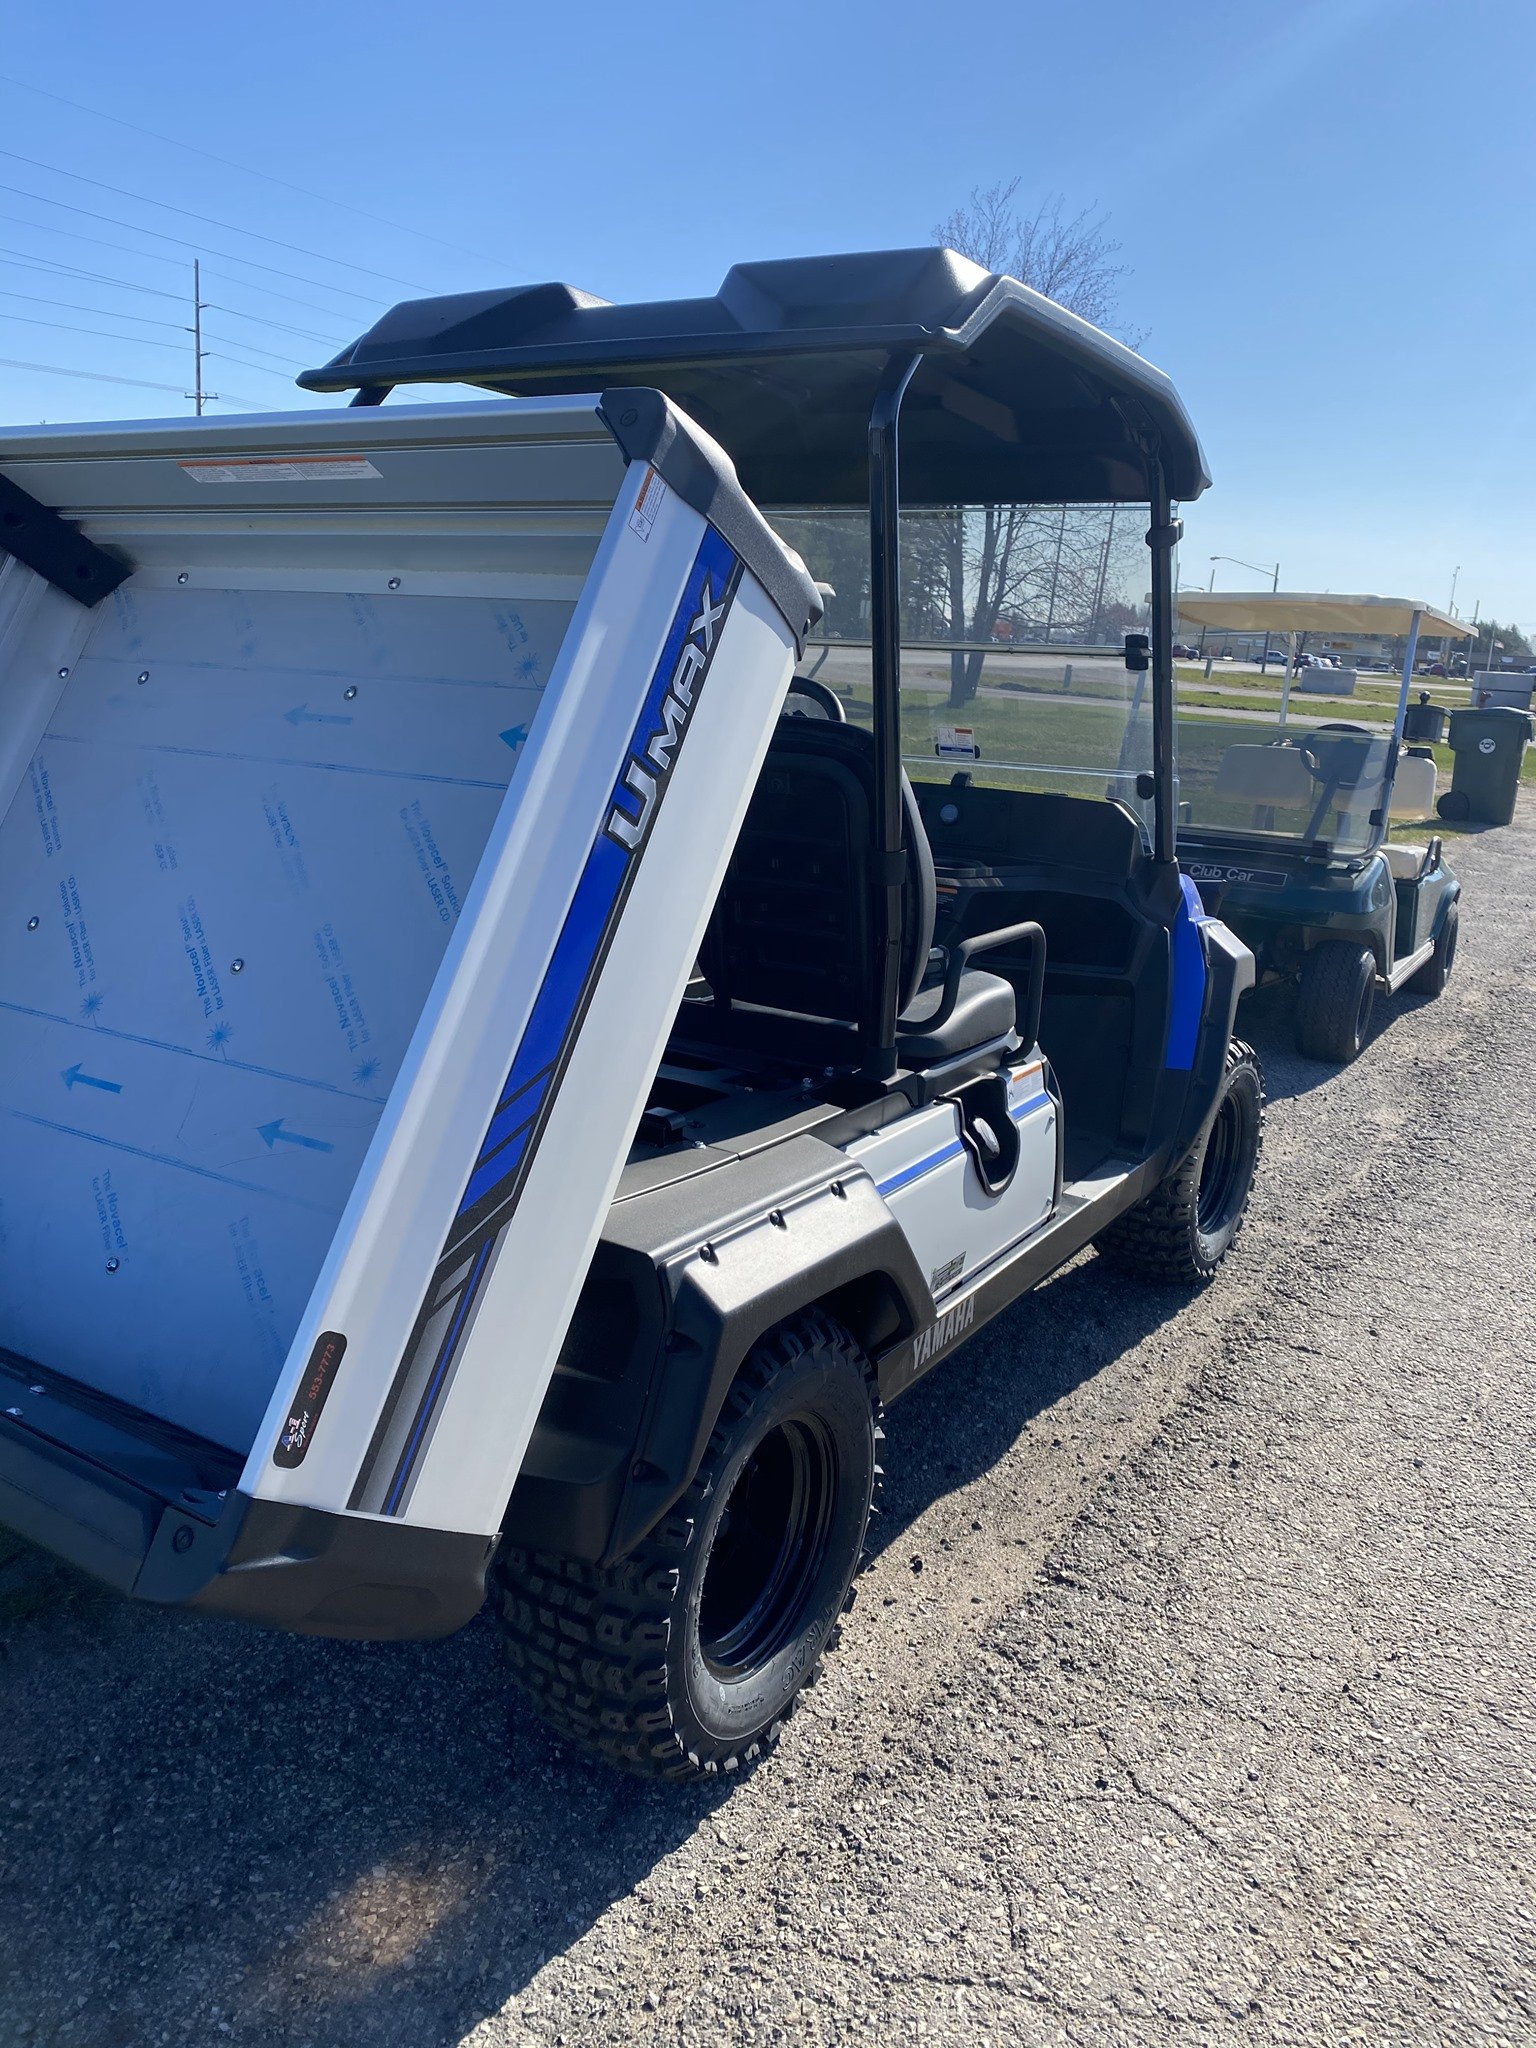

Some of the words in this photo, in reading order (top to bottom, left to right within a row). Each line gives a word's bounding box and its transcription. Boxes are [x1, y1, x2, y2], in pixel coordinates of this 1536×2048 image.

[608, 583, 725, 850] UMAX
[427, 877, 446, 908] LASER
[1189, 863, 1223, 878] Club
[1226, 867, 1255, 882] Car
[106, 1192, 128, 1249] Novacel
[913, 1293, 975, 1371] YAMAHA
[308, 1343, 336, 1401] 553-7773
[295, 1410, 310, 1448] Sport
